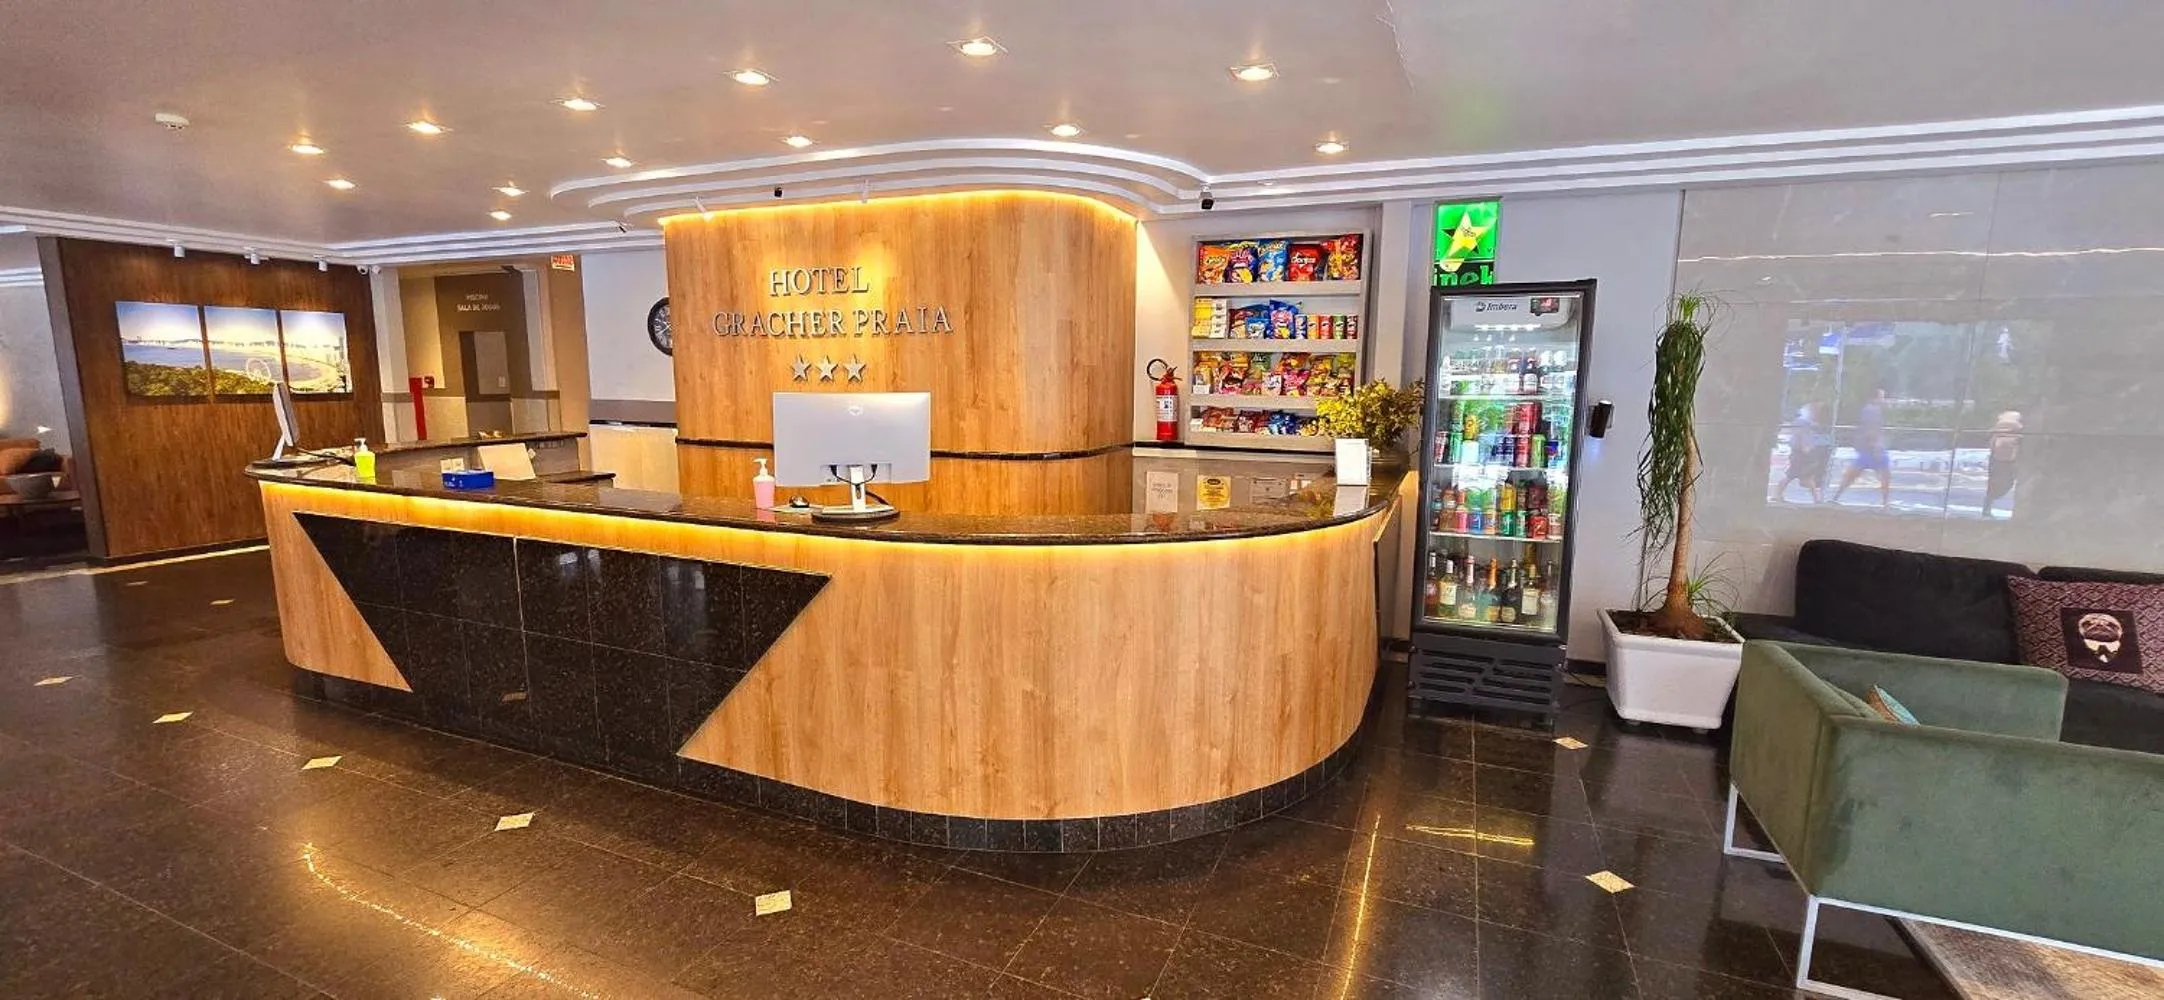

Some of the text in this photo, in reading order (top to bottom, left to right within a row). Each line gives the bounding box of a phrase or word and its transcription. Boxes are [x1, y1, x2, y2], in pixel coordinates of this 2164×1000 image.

[770, 266, 869, 296] HOTEL
[712, 305, 953, 338] GRACHER PRAIA
